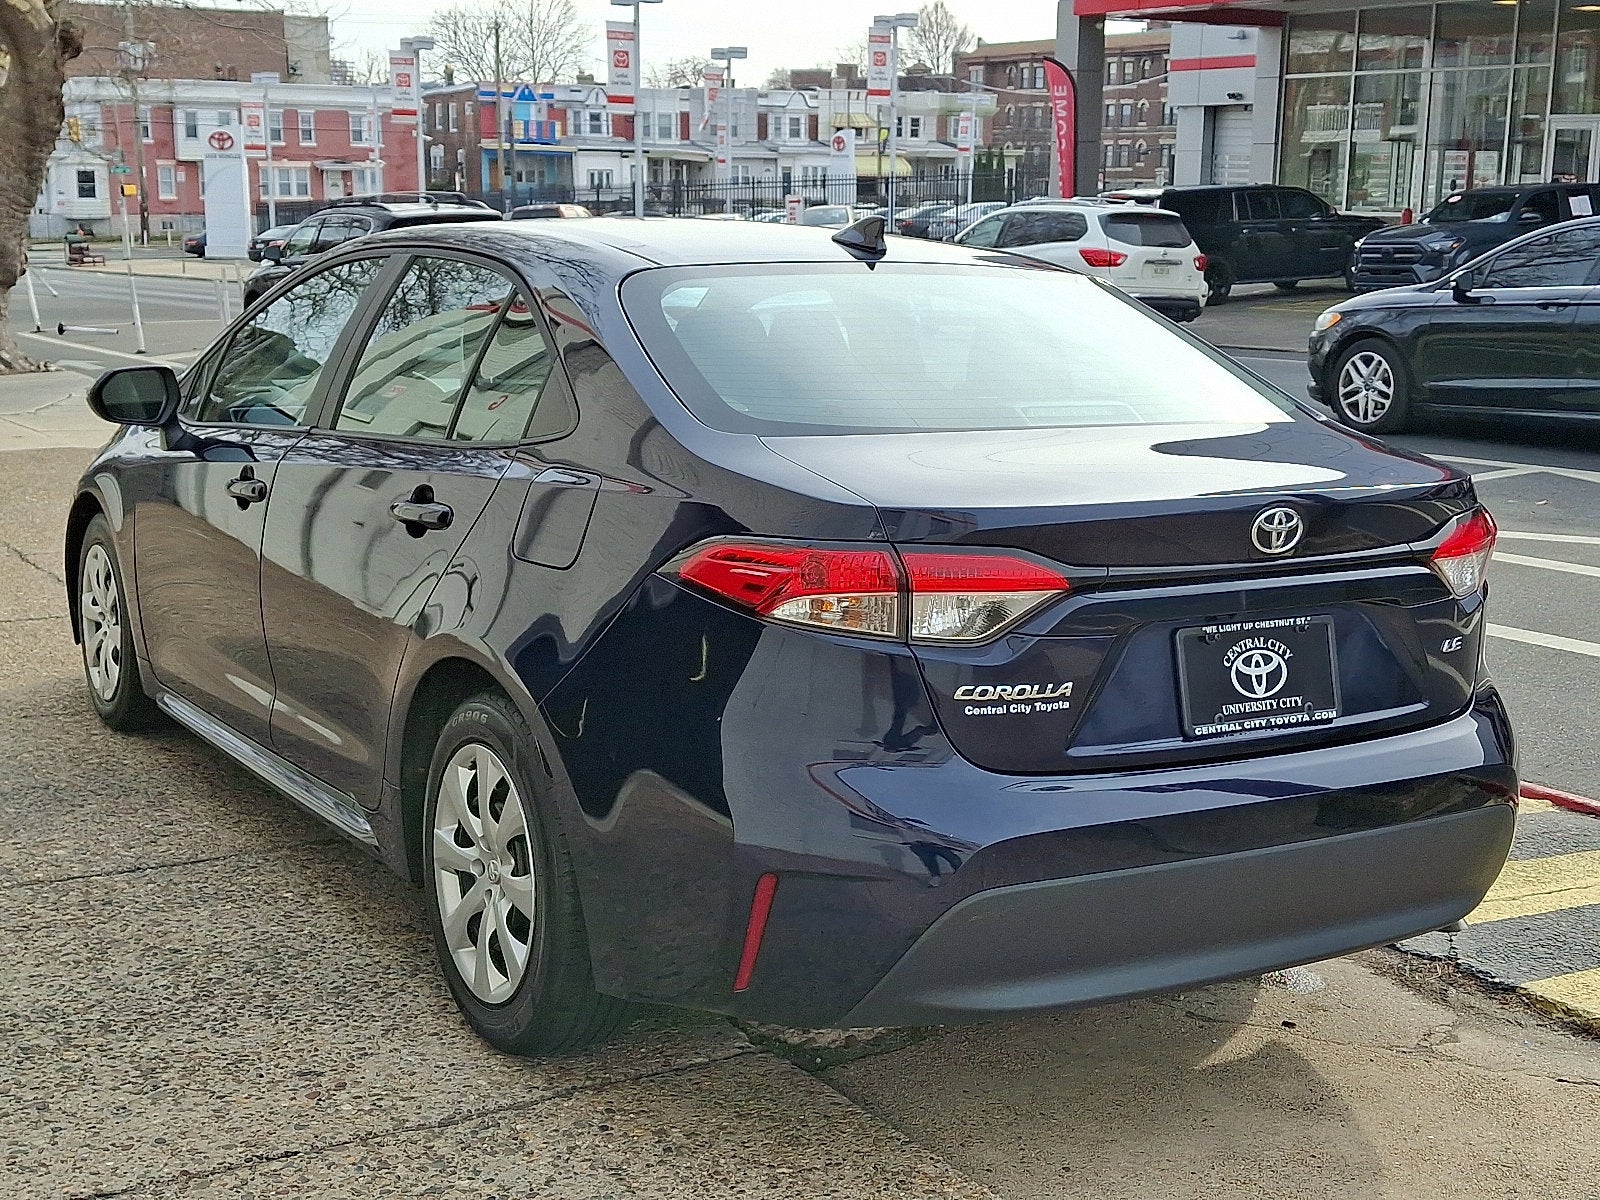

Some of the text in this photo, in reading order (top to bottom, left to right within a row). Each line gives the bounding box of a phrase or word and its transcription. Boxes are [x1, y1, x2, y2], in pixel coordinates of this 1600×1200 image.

[1219, 623, 1242, 633] LIGHT
[1243, 622, 1254, 630] UP
[1255, 618, 1295, 629] CHESTNUT
[1223, 637, 1294, 667] CENTRAL CITY
[1440, 636, 1463, 652] LE
[954, 682, 1073, 701] COROLLA
[965, 701, 1070, 715] Central City Toyota
[1222, 696, 1303, 715] UNIVERSITY CITY
[1195, 722, 1242, 735] CENTRAL
[1244, 719, 1267, 729] CITY
[1270, 714, 1310, 725] TOYOTA
